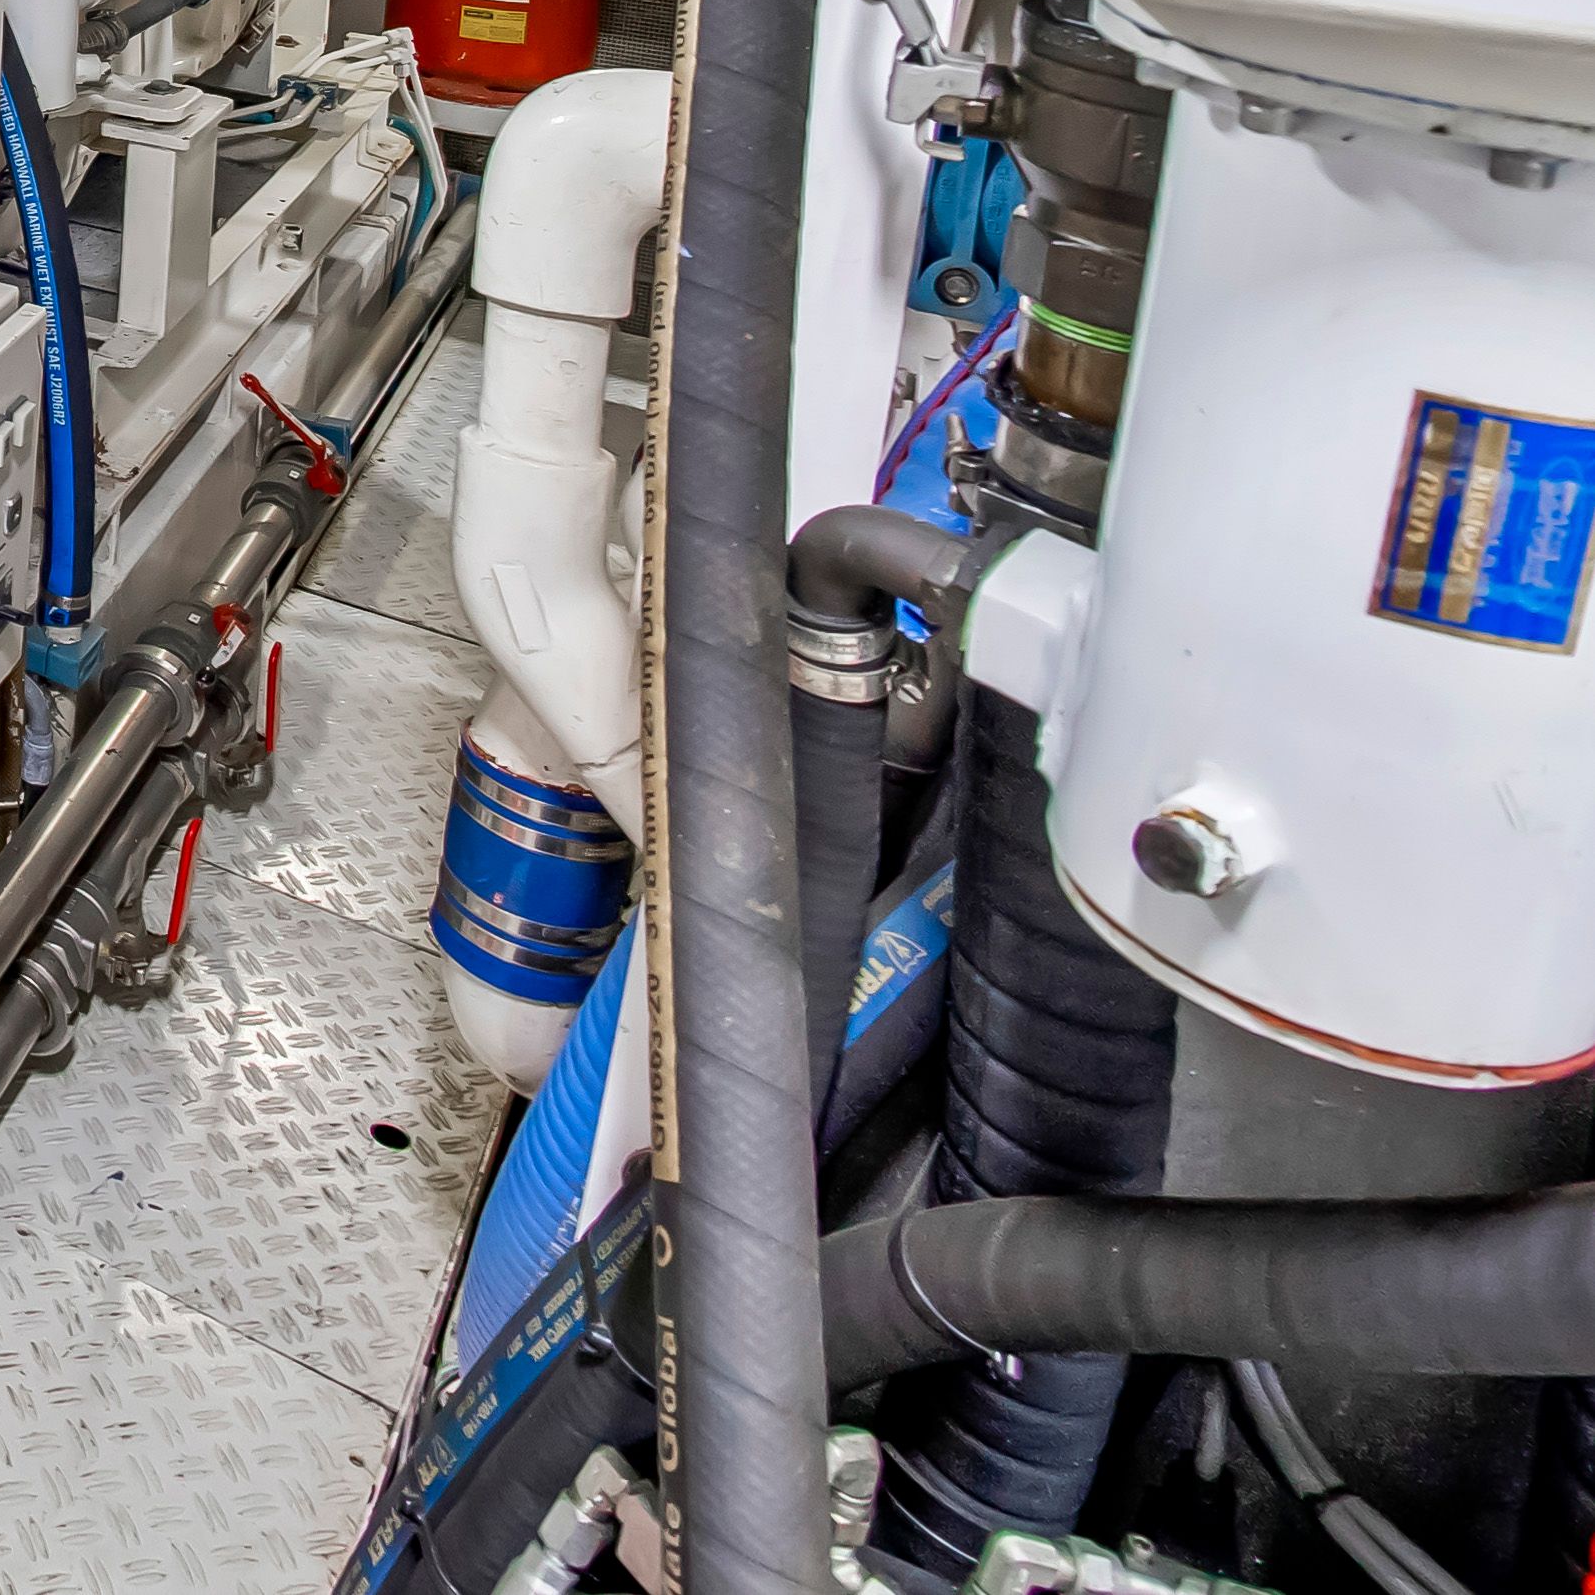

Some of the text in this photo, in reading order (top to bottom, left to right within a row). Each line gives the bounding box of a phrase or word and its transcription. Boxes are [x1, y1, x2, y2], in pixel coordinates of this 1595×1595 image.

[7, 133, 33, 201] HARDWALL
[24, 202, 44, 253] MARINE
[35, 254, 50, 283] WET
[48, 346, 61, 371] SAE
[49, 373, 66, 426] J2006R2
[656, 1315, 679, 1472] Global
